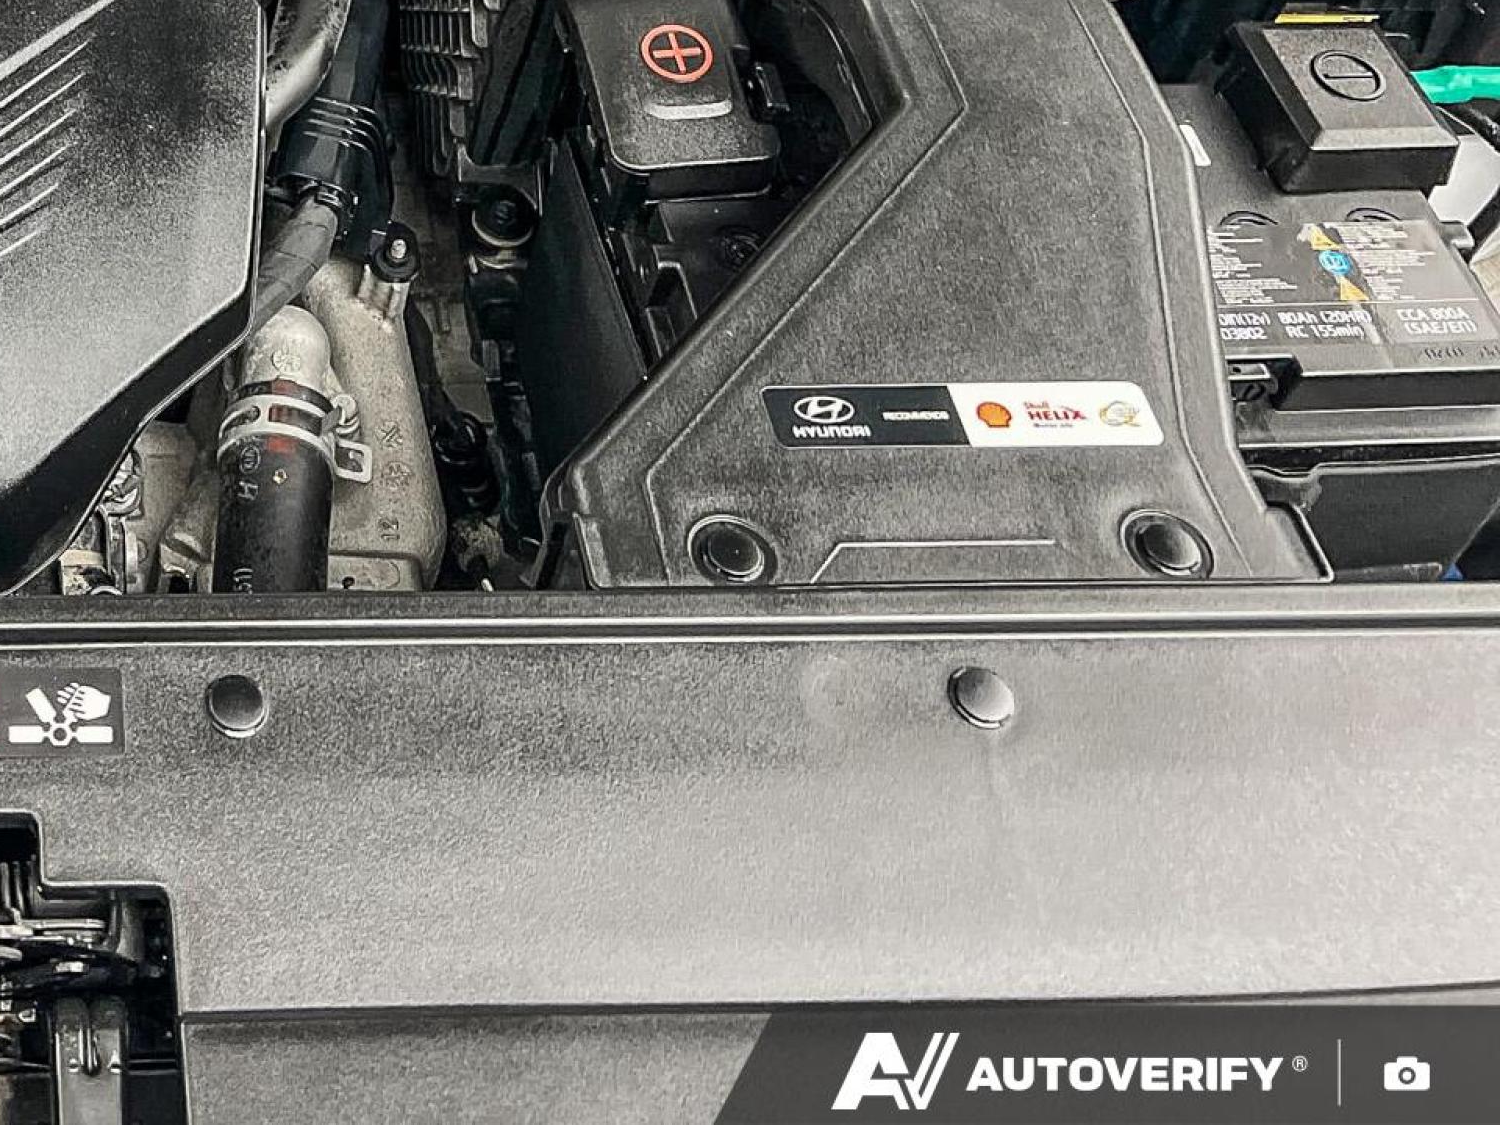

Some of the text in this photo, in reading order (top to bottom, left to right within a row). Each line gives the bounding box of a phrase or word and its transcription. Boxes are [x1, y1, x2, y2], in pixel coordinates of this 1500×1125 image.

[1396, 307, 1430, 321] CCA
[1285, 325, 1309, 338] RC
[1027, 410, 1088, 421] HELIX
[791, 424, 873, 439] HYUNDAI
